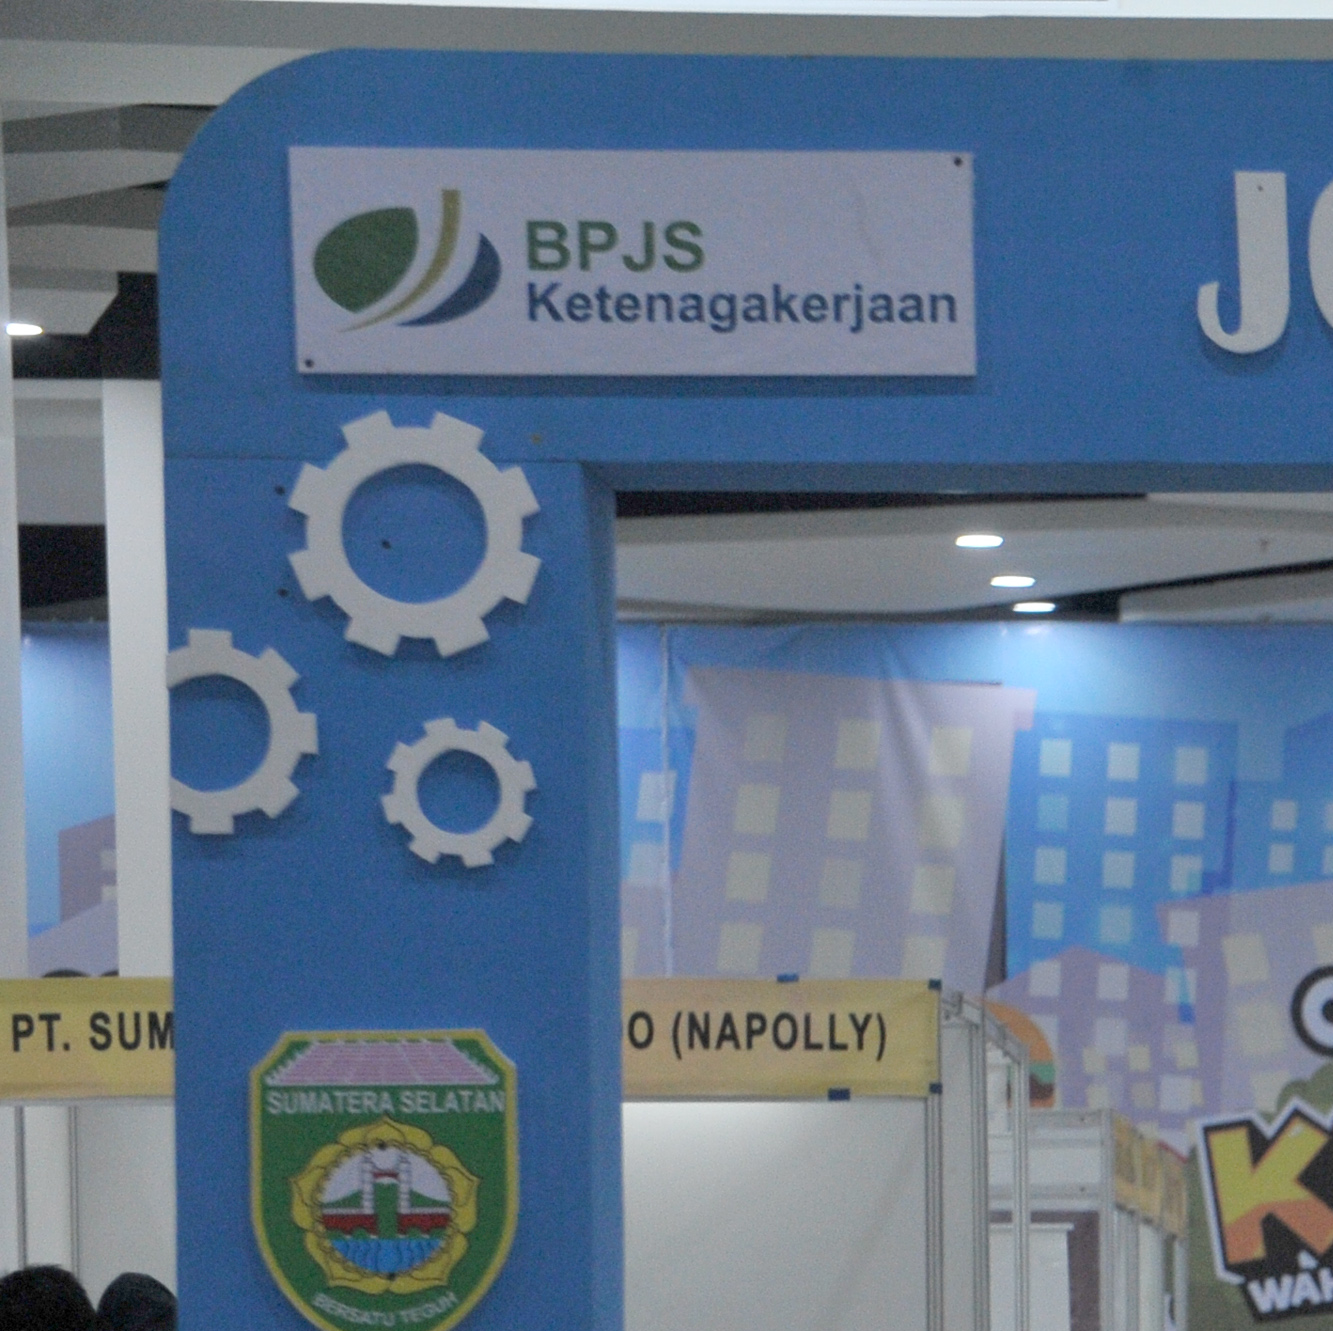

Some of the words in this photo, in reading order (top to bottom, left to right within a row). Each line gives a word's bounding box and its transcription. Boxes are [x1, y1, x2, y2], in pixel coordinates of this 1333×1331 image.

[525, 220, 706, 272] BPJS
[526, 282, 958, 333] Ketenagakerjaan
[12, 1012, 71, 1052] PT.
[88, 1011, 175, 1051] SUM
[627, 1010, 655, 1050] O
[671, 1010, 887, 1062] (NAPOLLY)
[266, 1089, 395, 1114] SUMATERA
[401, 1089, 505, 1113] SELATAN
[313, 1291, 397, 1327] BERSATU
